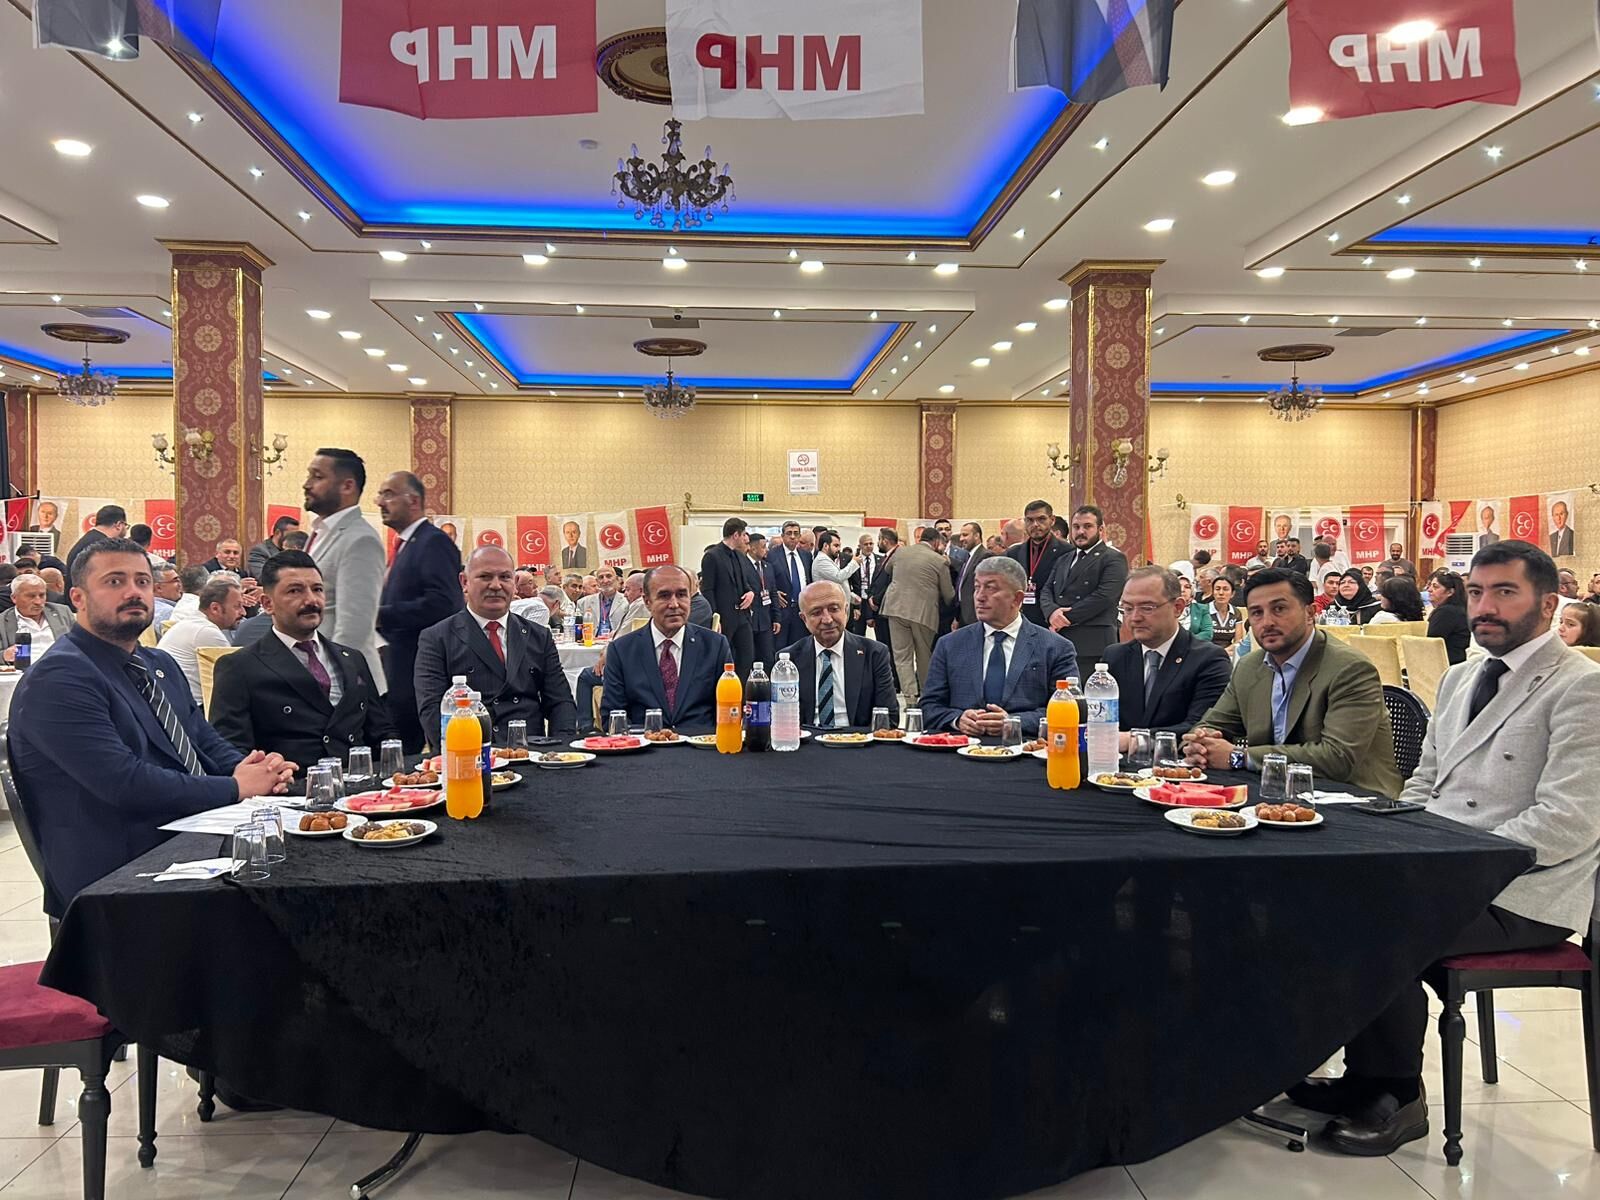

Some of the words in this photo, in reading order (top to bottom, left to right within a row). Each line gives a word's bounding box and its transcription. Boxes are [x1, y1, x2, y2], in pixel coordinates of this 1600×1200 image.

[646, 553, 669, 564] MHP
[1231, 551, 1253, 560] MHP
[1356, 550, 1379, 559] MHP
[604, 558, 627, 567] MHP
